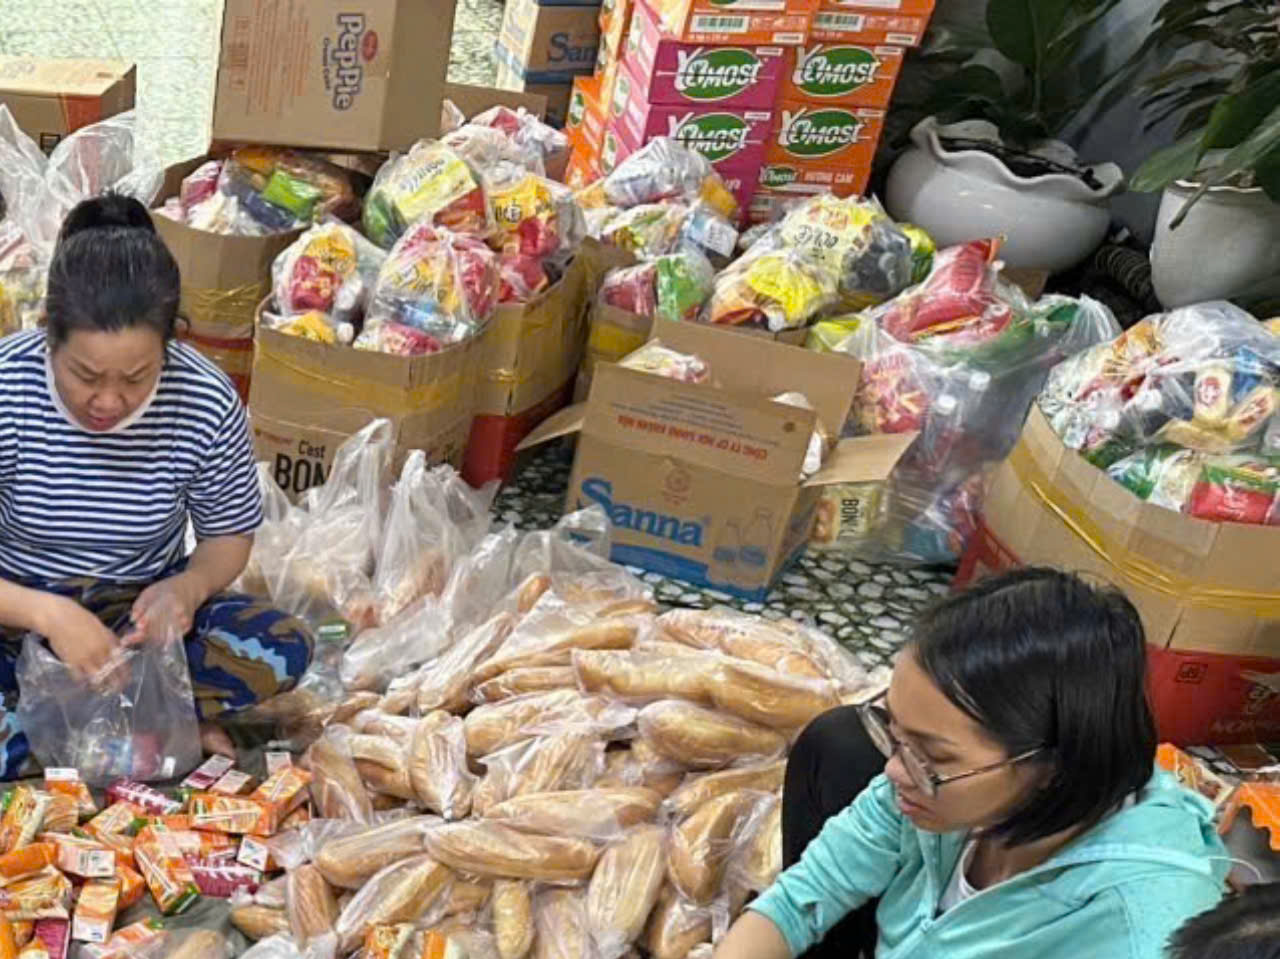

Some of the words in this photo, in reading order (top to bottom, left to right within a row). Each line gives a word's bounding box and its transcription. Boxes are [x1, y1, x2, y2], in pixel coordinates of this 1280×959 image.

[332, 13, 365, 111] PepPie
[548, 32, 598, 63] San
[581, 477, 703, 547] Sanna
